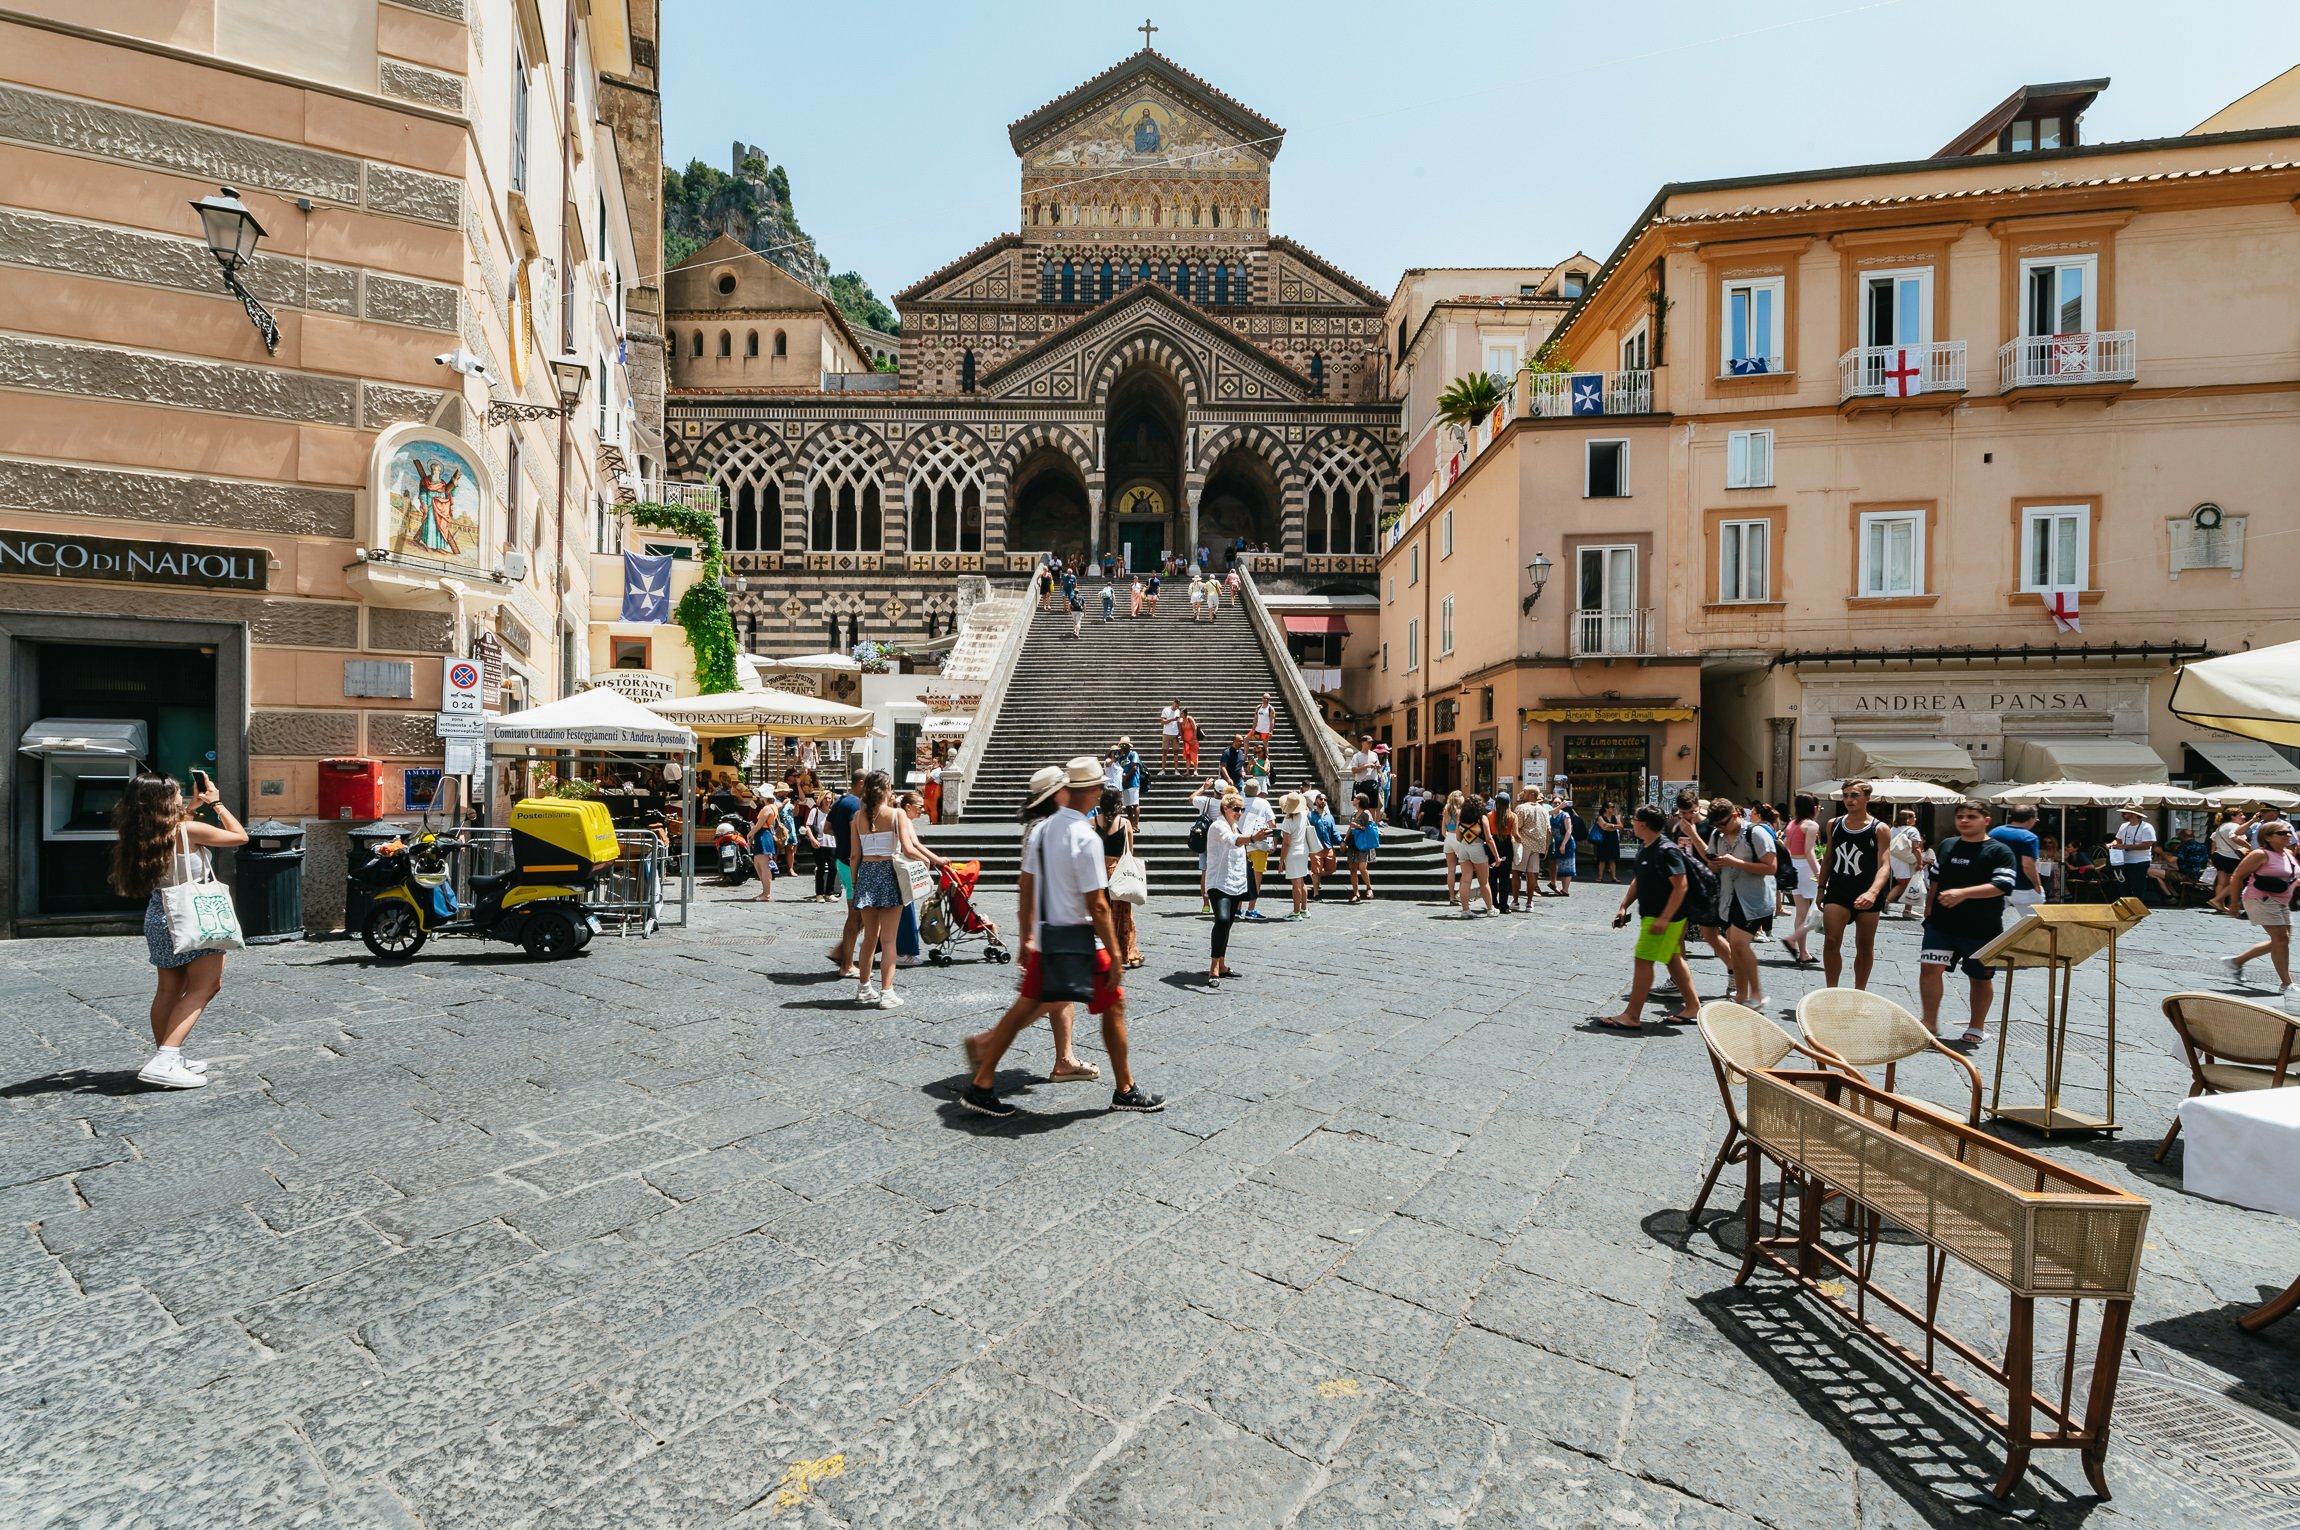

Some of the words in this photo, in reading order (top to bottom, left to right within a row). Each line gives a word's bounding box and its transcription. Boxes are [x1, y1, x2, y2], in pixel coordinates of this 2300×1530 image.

[127, 549, 255, 580] NAPOLI
[594, 679, 673, 693] RISTORANTE
[613, 688, 662, 699] ZZERIA
[1856, 695, 1966, 711] ANDREA
[1991, 694, 2088, 710] PANSA
[751, 713, 814, 725] PIZZERIA
[820, 715, 848, 726] BAR
[1566, 711, 1592, 719] Antichi
[1595, 711, 1621, 720] Sapori
[494, 727, 529, 739] Comitato
[530, 728, 565, 740] Cittadino
[567, 729, 618, 744] Festeggiamenti
[621, 730, 628, 742] S.
[630, 731, 655, 743] Andrea
[656, 732, 686, 747] Apostolo
[1590, 738, 1640, 746] Limoncello
